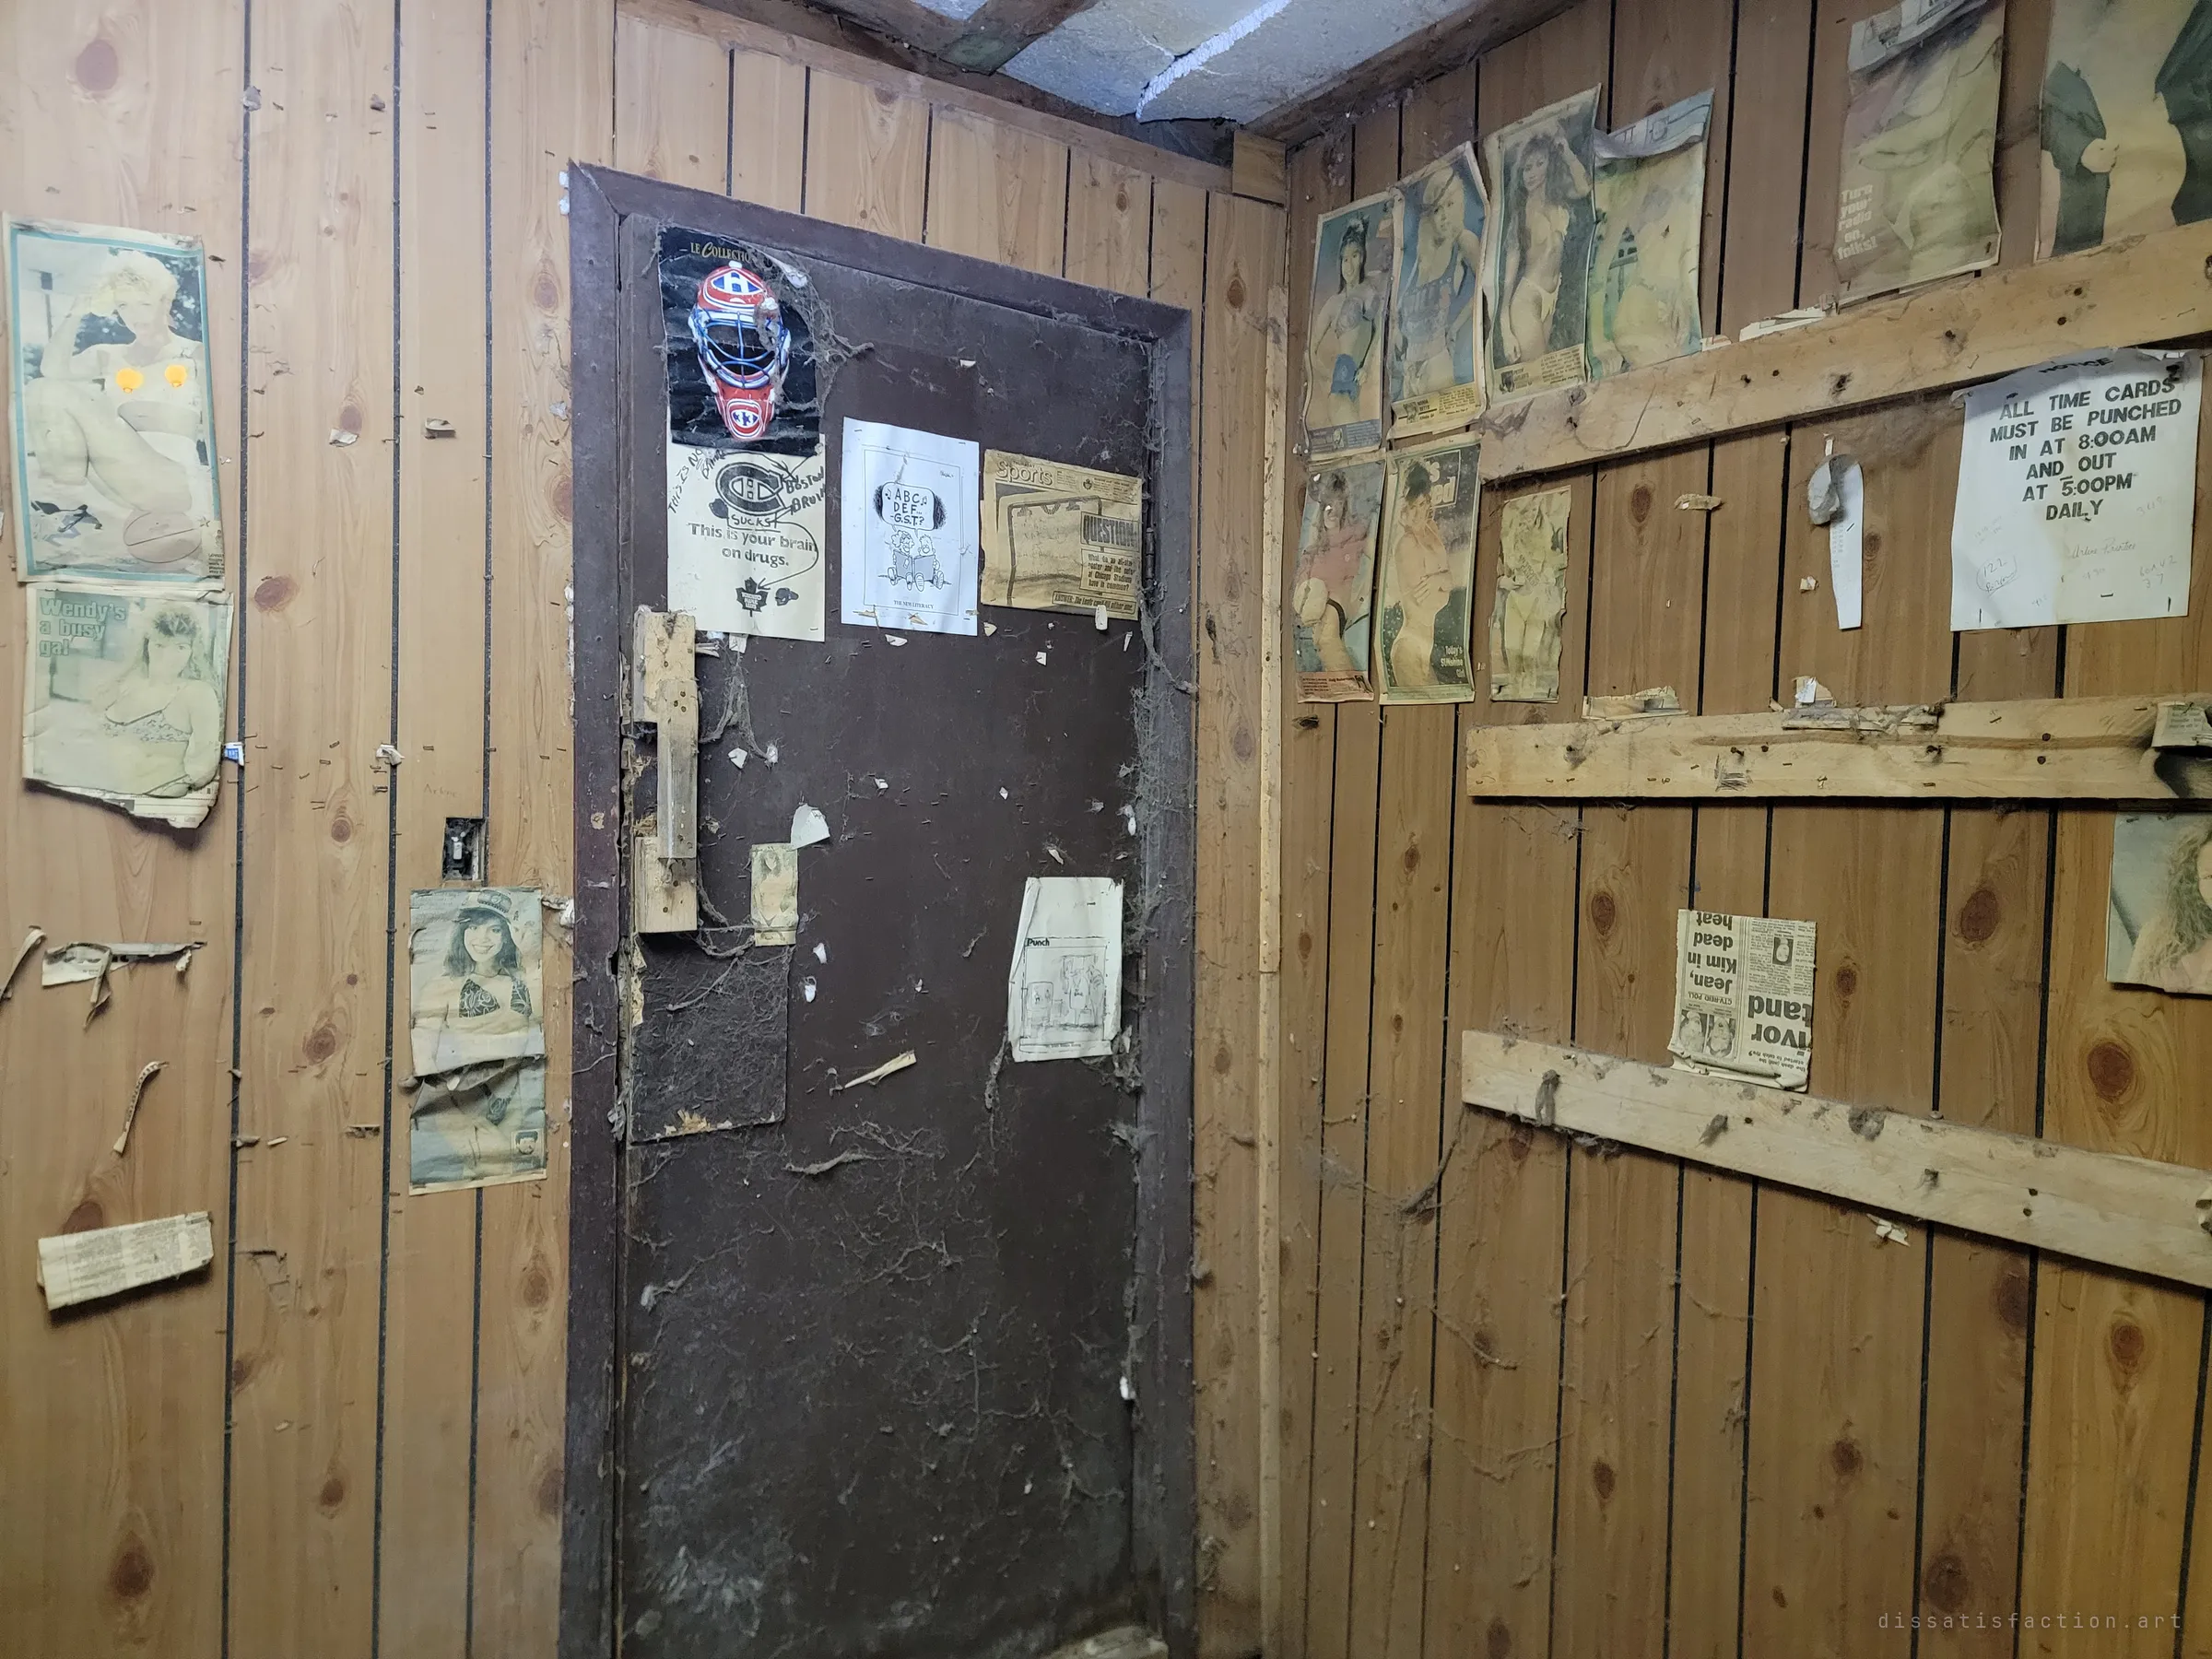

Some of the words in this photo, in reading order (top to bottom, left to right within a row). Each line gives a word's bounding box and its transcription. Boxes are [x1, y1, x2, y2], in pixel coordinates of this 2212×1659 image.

[1841, 184, 1873, 203] Turn
[1841, 199, 1867, 219] your
[1838, 210, 1872, 231] radio
[1837, 236, 1877, 260] folks!
[2000, 399, 2034, 420] ALL
[2049, 391, 2091, 411] TIME
[2104, 379, 2176, 402] CARDS
[1990, 420, 2039, 442] MUST
[2051, 414, 2074, 433] BE
[2087, 398, 2183, 426] PUNCHED
[2009, 445, 2028, 461] IN
[2039, 438, 2065, 457] AT
[2077, 425, 2157, 451] 8:00AM
[995, 460, 1053, 486] Sports
[2026, 461, 2065, 480] AND
[2077, 452, 2117, 472] OUT
[2022, 484, 2048, 501] AT
[2061, 473, 2133, 498] 5:00PM
[2046, 500, 2104, 521] DAILY
[688, 523, 723, 537] This
[726, 528, 738, 540] is
[742, 532, 776, 545] your
[780, 535, 818, 552] brain
[722, 547, 741, 559] on
[745, 549, 789, 568] drugs.
[1094, 571, 1112, 581] Chicago
[1112, 573, 1133, 583] Stadium
[40, 597, 127, 621] Wendy's
[40, 619, 52, 634] a
[59, 622, 106, 639] busy
[40, 638, 70, 658] gal
[1695, 912, 1733, 931] heat
[1027, 937, 1050, 947] Punch
[1693, 931, 1734, 951] dead
[1688, 952, 1701, 969] in
[1706, 956, 1737, 975] Kim
[1689, 971, 1733, 994] Jean,
